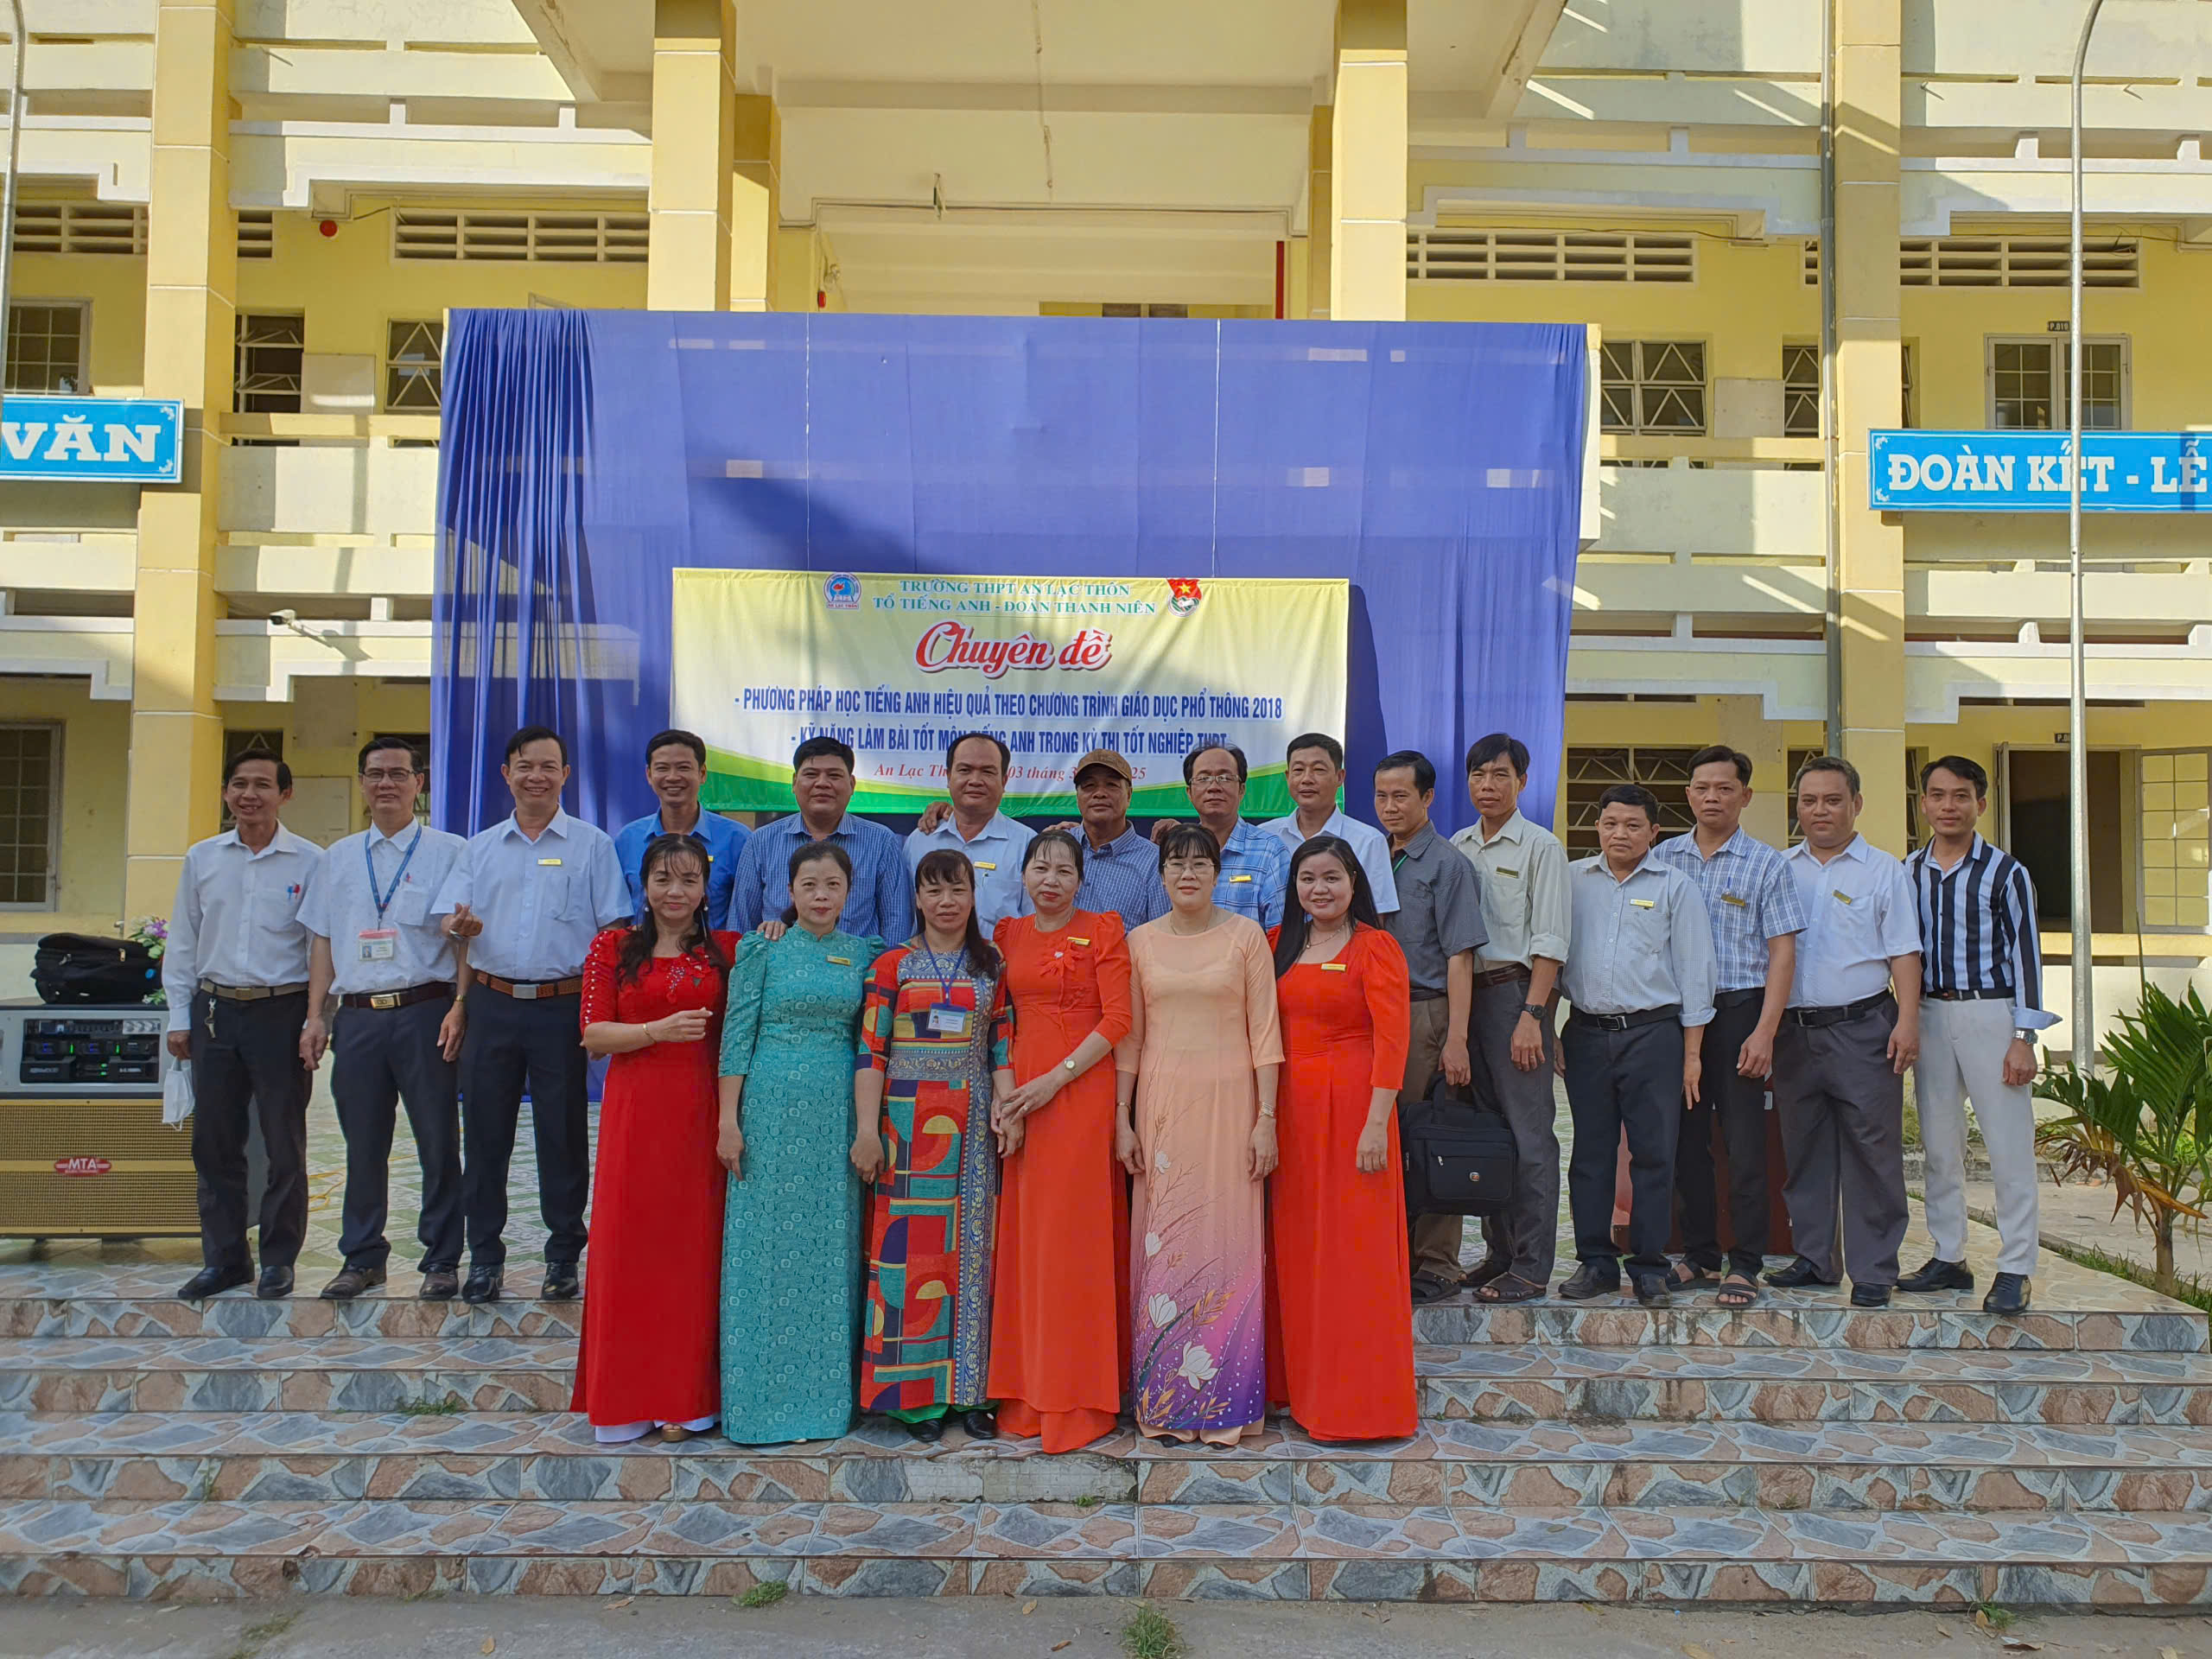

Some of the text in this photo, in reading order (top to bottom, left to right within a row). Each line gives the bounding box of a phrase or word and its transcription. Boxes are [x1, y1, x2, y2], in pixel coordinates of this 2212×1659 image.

[1, 413, 162, 462] VĂN
[1887, 440, 2208, 493] ĐOÀN KẾT - LỄ
[900, 578, 1130, 597] TRƯỜNG THPT AN LẠC THÔN
[873, 593, 895, 609] TỔ
[899, 594, 951, 611] TIẾNG
[956, 601, 991, 612] ANH
[1004, 599, 1051, 613] ĐOÀN
[1055, 601, 1111, 613] THANH
[1116, 600, 1156, 614] NIÊN
[914, 620, 1108, 676] Chuyên đề
[744, 685, 795, 711] PHƯƠNG
[799, 685, 832, 712] PHÁP
[836, 690, 861, 717] HỌC
[865, 684, 901, 714] TIẾNG
[905, 691, 930, 715] ANH
[934, 688, 963, 720] HIỆU
[966, 685, 991, 717] QUẢ
[995, 694, 1026, 716] THEO
[1029, 690, 1078, 717] CHƯƠNG
[1083, 691, 1118, 717] TRÌNH
[1122, 690, 1149, 717] GIÁO
[1154, 696, 1178, 722] DỤC
[1181, 688, 1207, 718] PHỔ
[1210, 692, 1249, 719] THÔNG
[1252, 697, 1282, 719] 2018
[858, 722, 885, 750] LÀM
[889, 723, 909, 750] BÀI
[913, 722, 935, 751] TỐT
[1010, 731, 1035, 753] ANH
[1039, 731, 1078, 753] TRONG
[1083, 728, 1097, 753] KỲ
[1102, 732, 1120, 753] THI
[1124, 725, 1144, 753] TỐT
[1148, 728, 1193, 759] NGHIỆP
[874, 763, 893, 776] An
[899, 764, 924, 779] Lạc
[1007, 766, 1022, 779] 03
[1027, 766, 1065, 782] tháng
[69, 1158, 97, 1170] MTA
